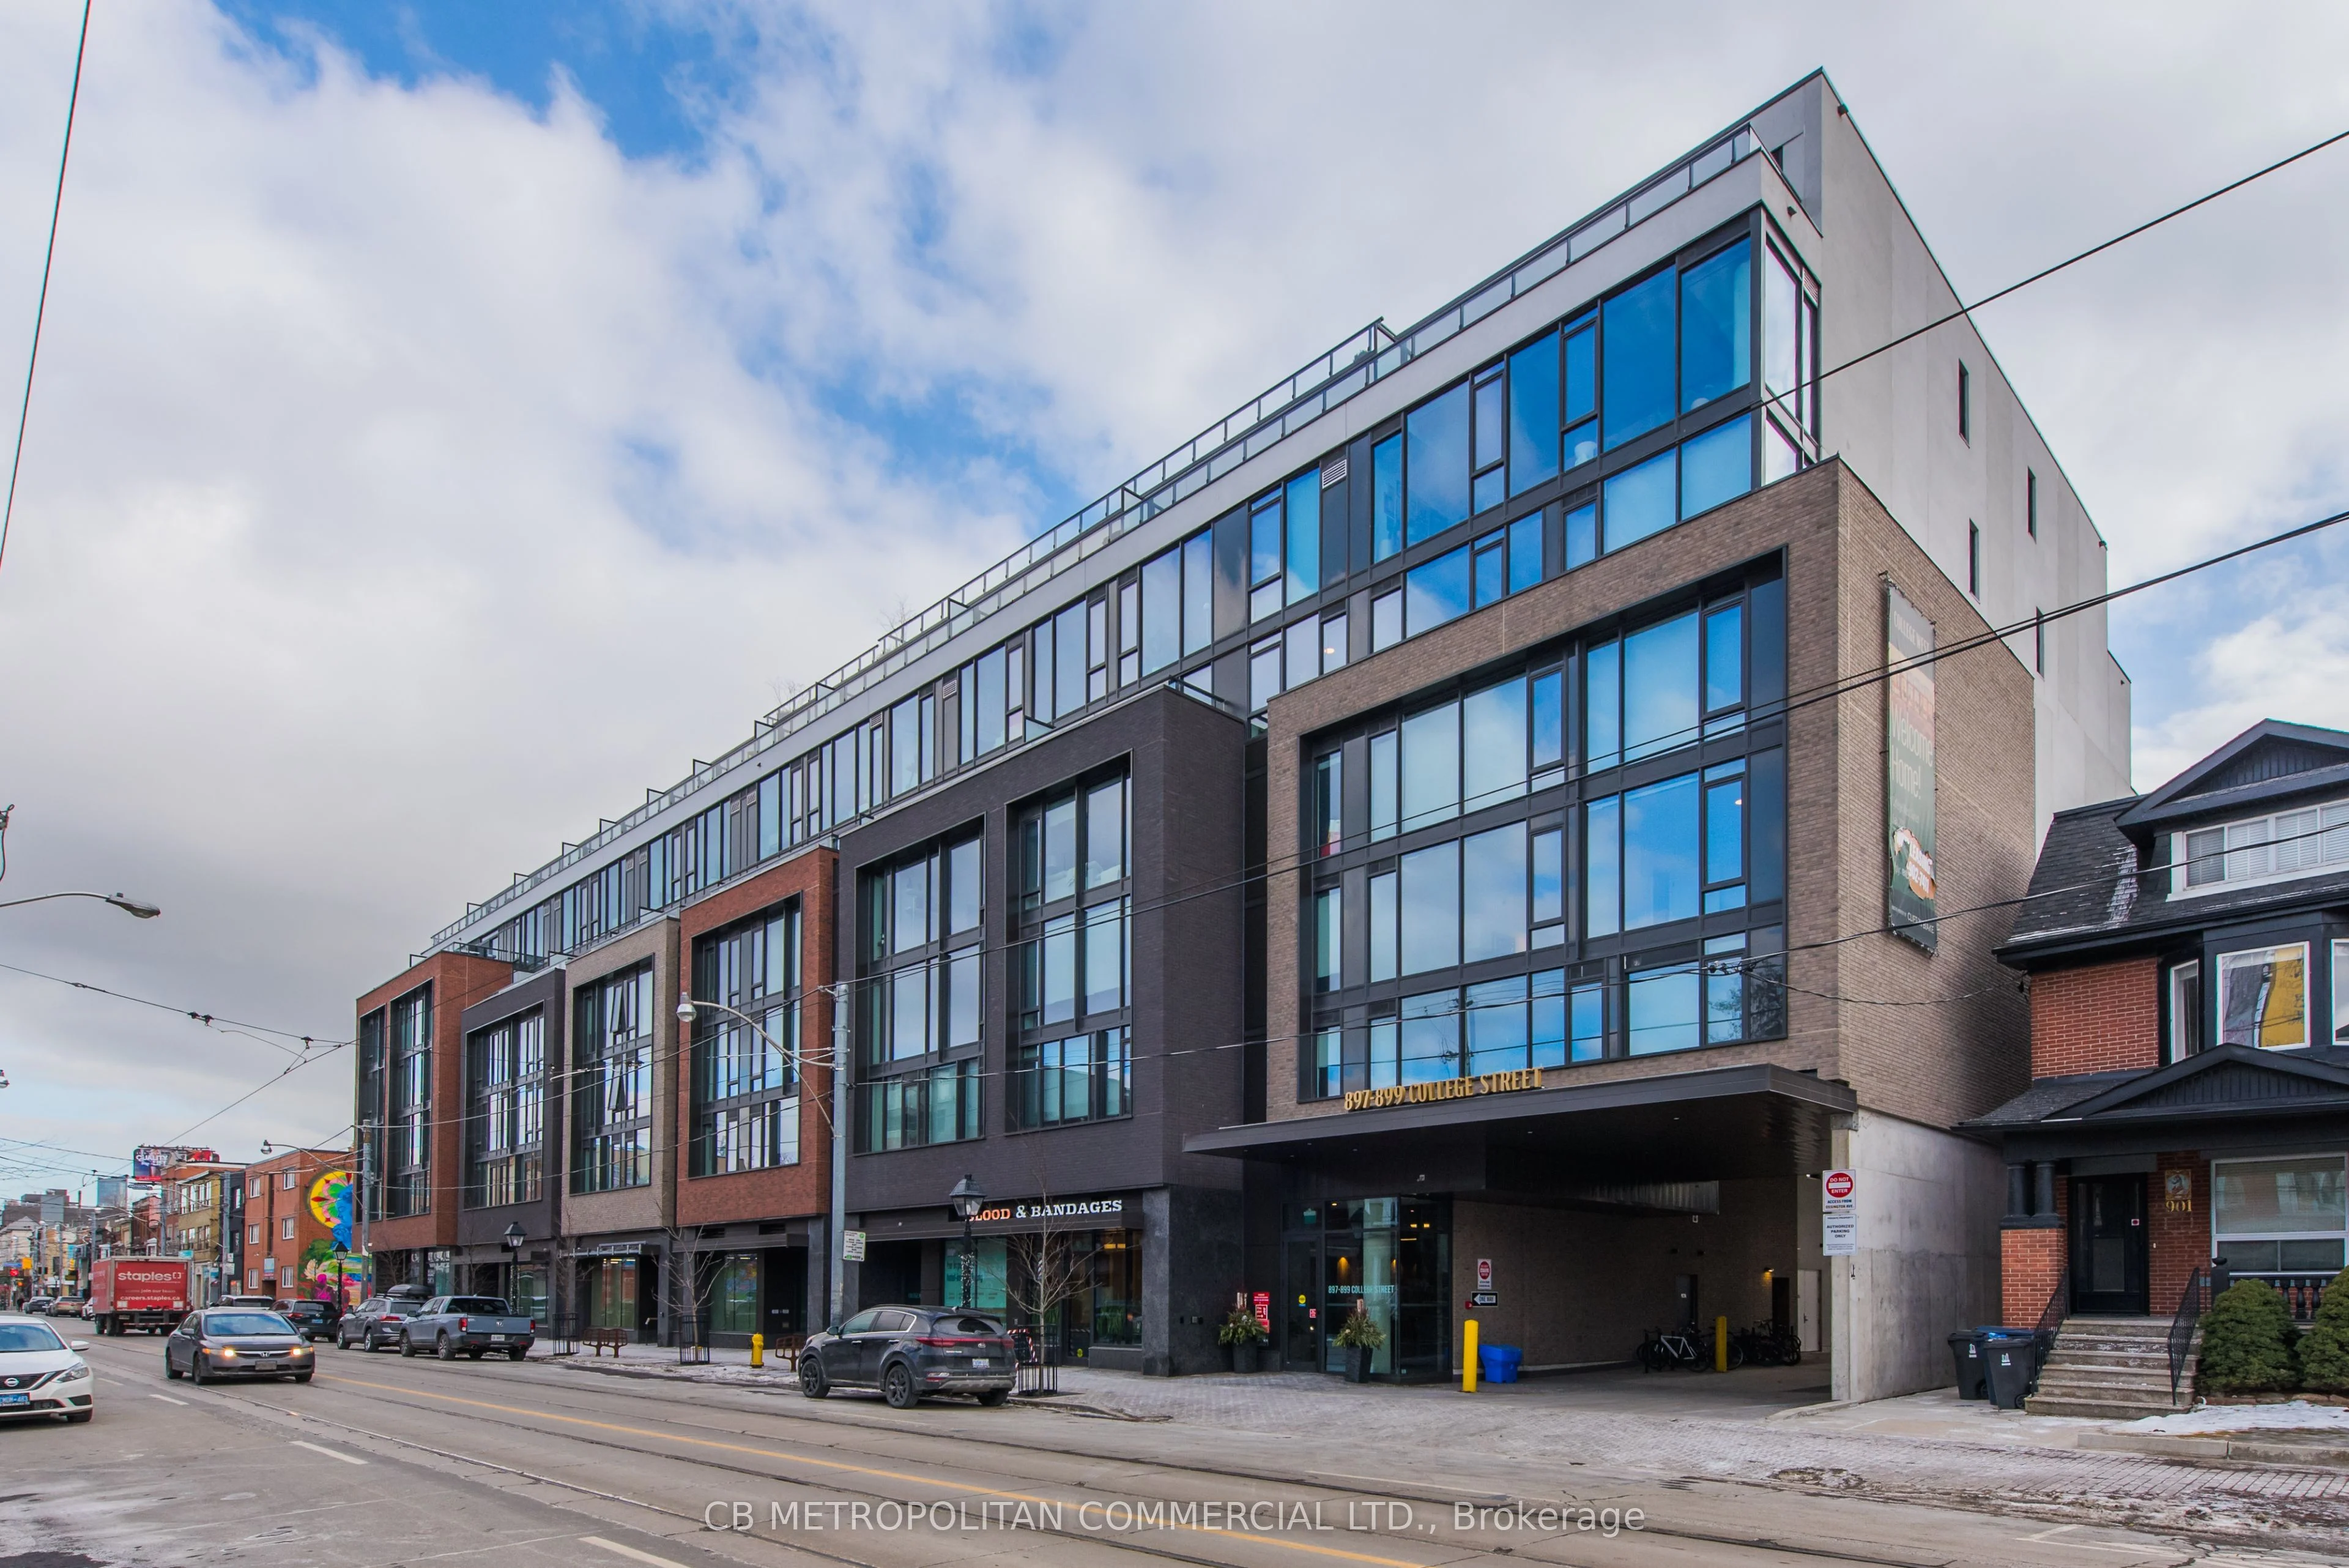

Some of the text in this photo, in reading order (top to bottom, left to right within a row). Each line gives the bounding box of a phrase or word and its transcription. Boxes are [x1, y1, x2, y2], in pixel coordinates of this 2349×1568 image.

[1893, 611, 1916, 646] COLLEGE
[1890, 708, 1933, 767] Welcome
[1891, 745, 1921, 800] Home!
[1345, 1067, 1544, 1111] 897-899 COLLEGE STREET
[965, 1199, 1123, 1222] LOOD & BANDAGES
[2166, 1199, 2192, 1213] 901
[118, 1271, 172, 1282] staples
[1328, 1285, 1395, 1294] 897-899 COLLEGE STREET
